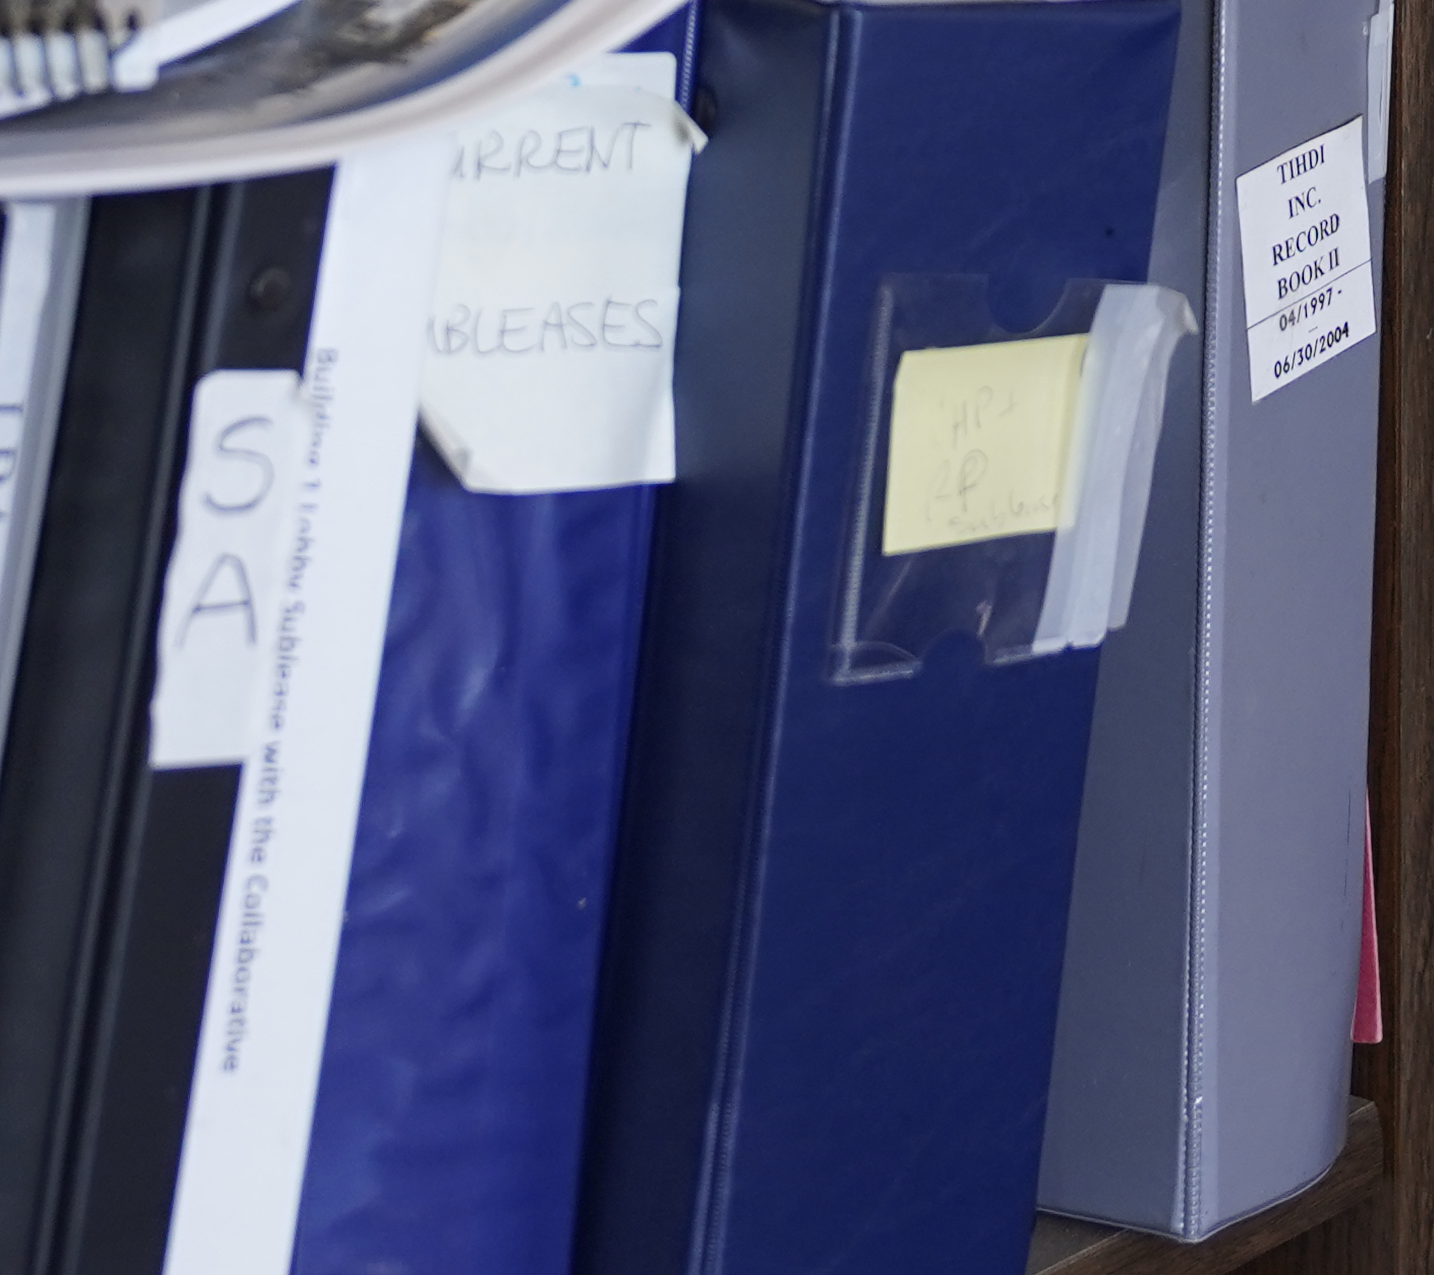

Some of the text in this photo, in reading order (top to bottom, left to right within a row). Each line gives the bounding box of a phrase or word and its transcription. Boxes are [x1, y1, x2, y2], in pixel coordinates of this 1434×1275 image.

[1276, 144, 1326, 185] TIHDI
[1288, 187, 1322, 220] INC.
[1271, 213, 1341, 266] RECORD
[1277, 247, 1340, 300] BOOK II
[1278, 287, 1333, 332] 04/1997
[1274, 321, 1350, 379] 06/30/2004
[256, 741, 284, 805] with
[251, 815, 276, 864] the
[222, 873, 270, 1073] Collaborative
